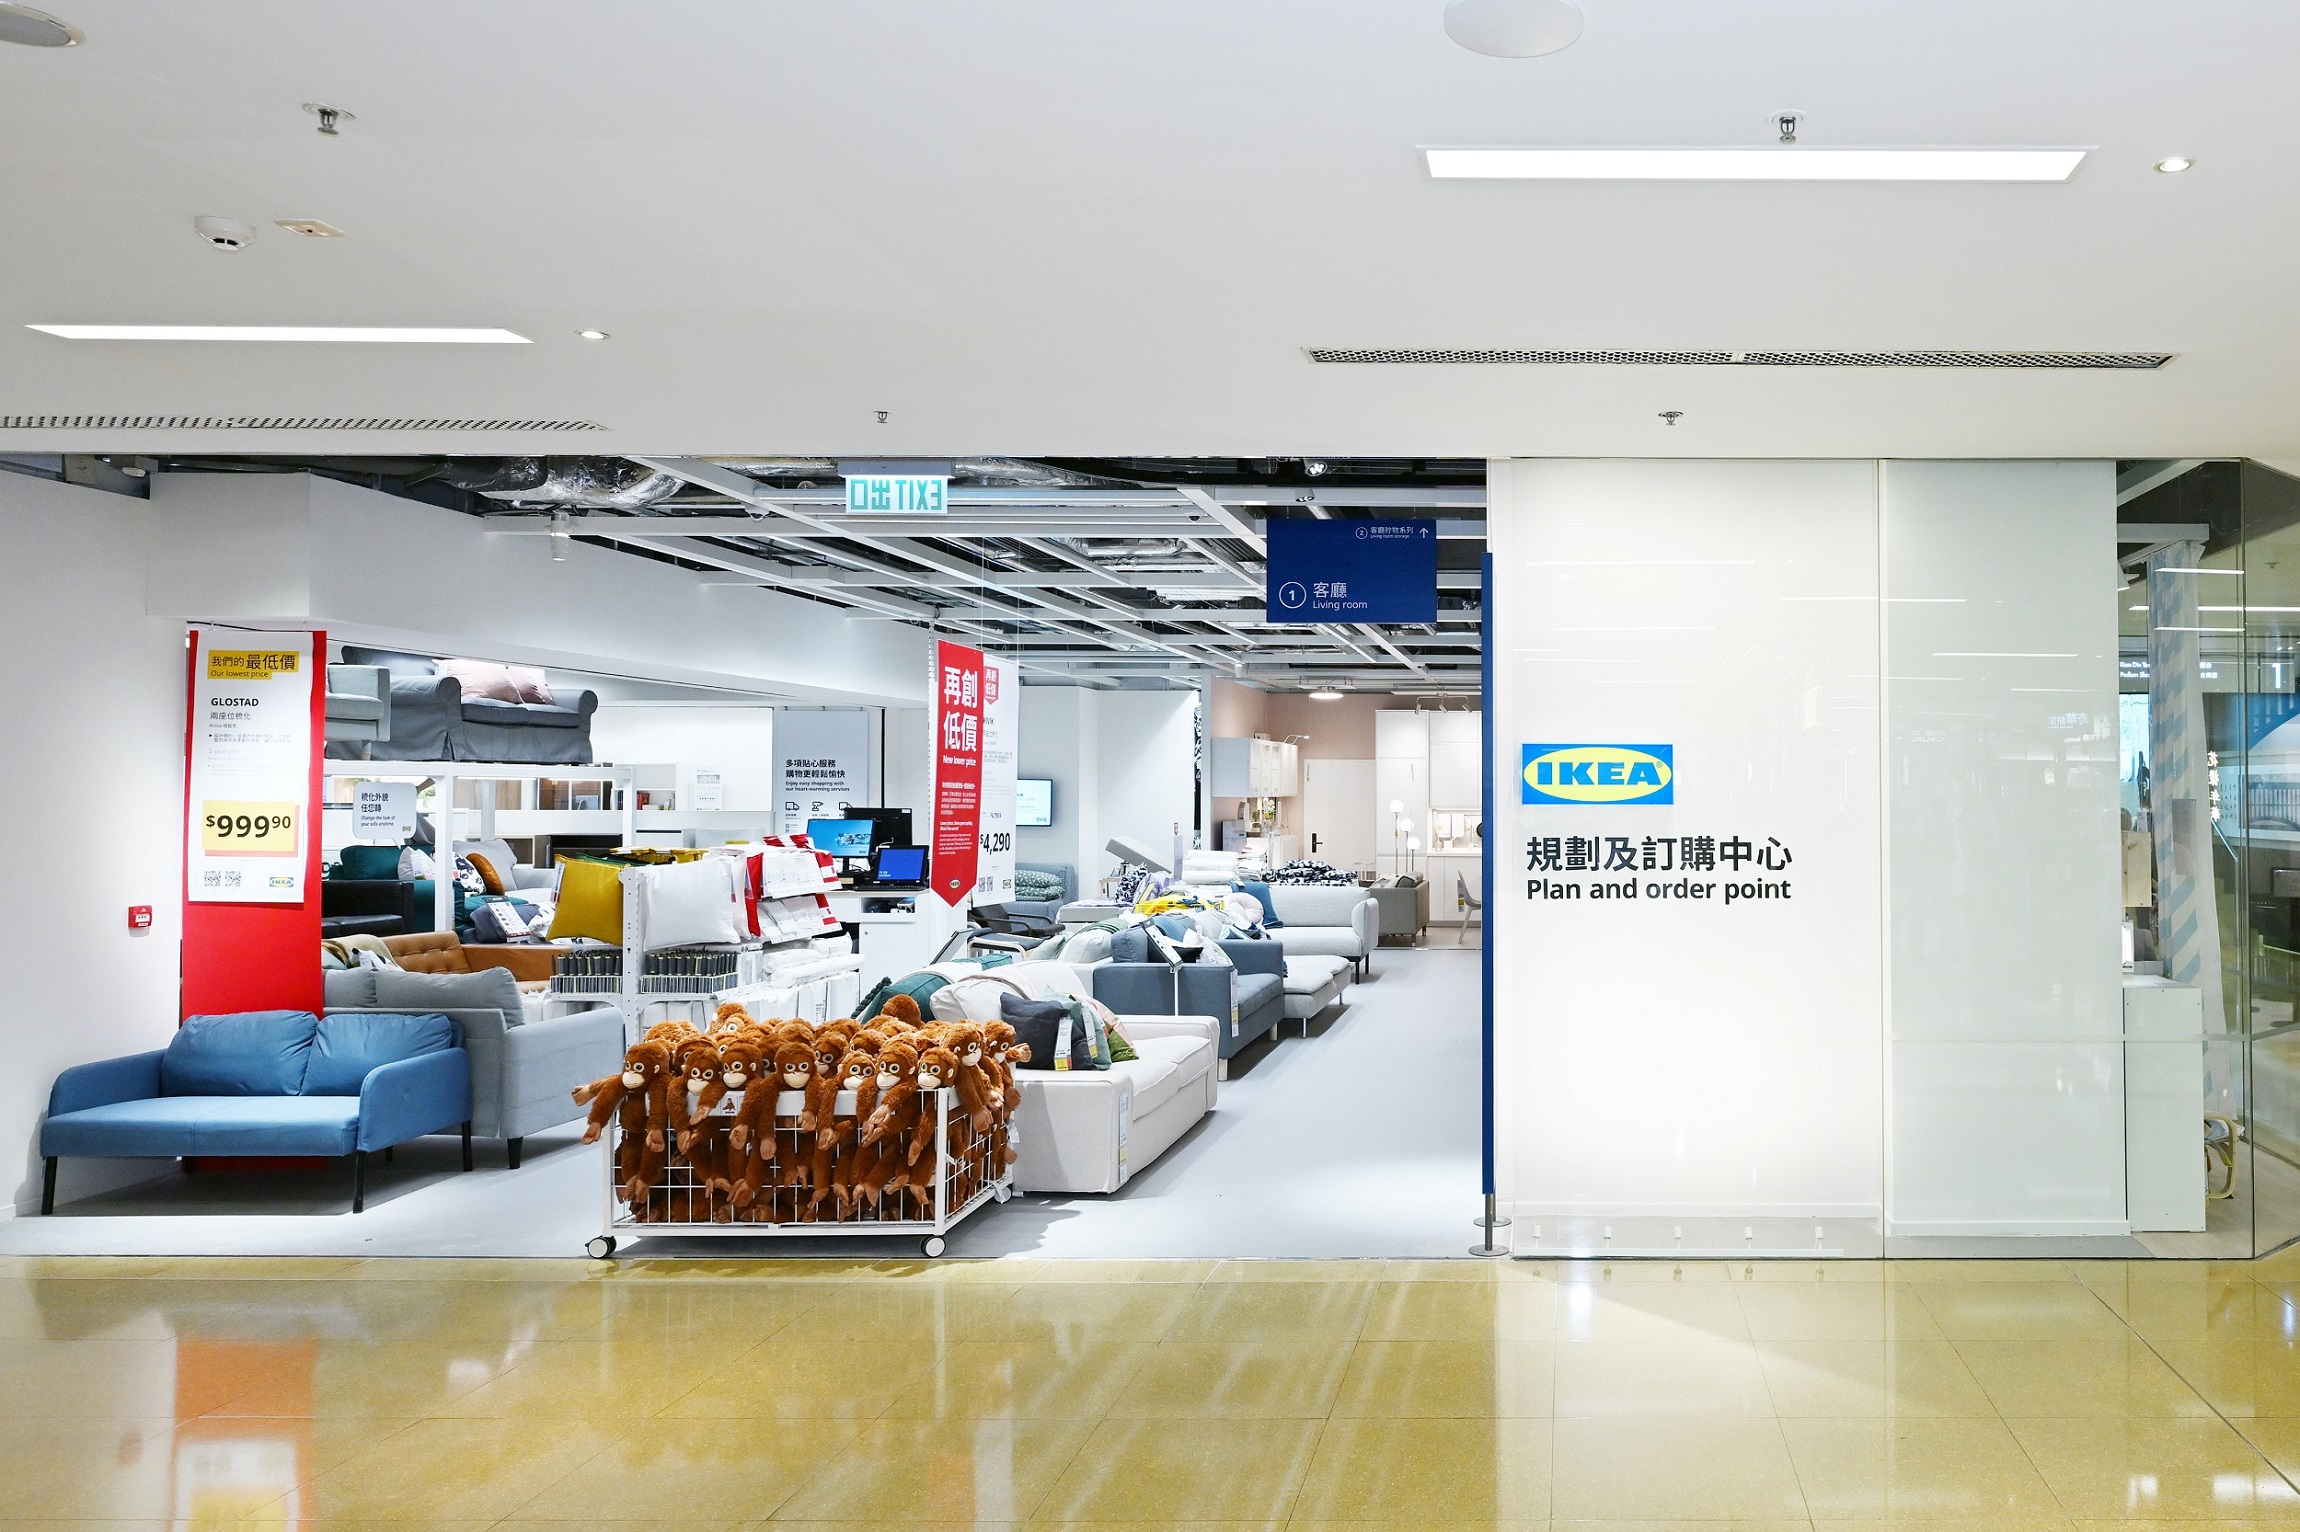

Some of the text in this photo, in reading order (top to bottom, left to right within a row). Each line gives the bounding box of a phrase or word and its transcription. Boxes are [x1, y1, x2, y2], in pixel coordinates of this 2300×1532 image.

[1312, 581, 1348, 599] 客廳
[1312, 600, 1368, 611] Living room
[211, 670, 269, 679] Our lowest price
[943, 665, 978, 709] 再創
[211, 697, 259, 707] GLOSTAD
[209, 711, 252, 721] 兩座位梳化
[943, 710, 978, 752] 低價
[785, 759, 836, 768] 多項貼心服務
[943, 754, 977, 769] New lower price
[785, 769, 846, 779] 購物更輕鬆愉快
[1537, 761, 1663, 786] IKEA
[979, 832, 1012, 856] $4,290
[1526, 835, 1793, 873] 規劃及訂購中心
[1527, 877, 1792, 905] Plan and order point
